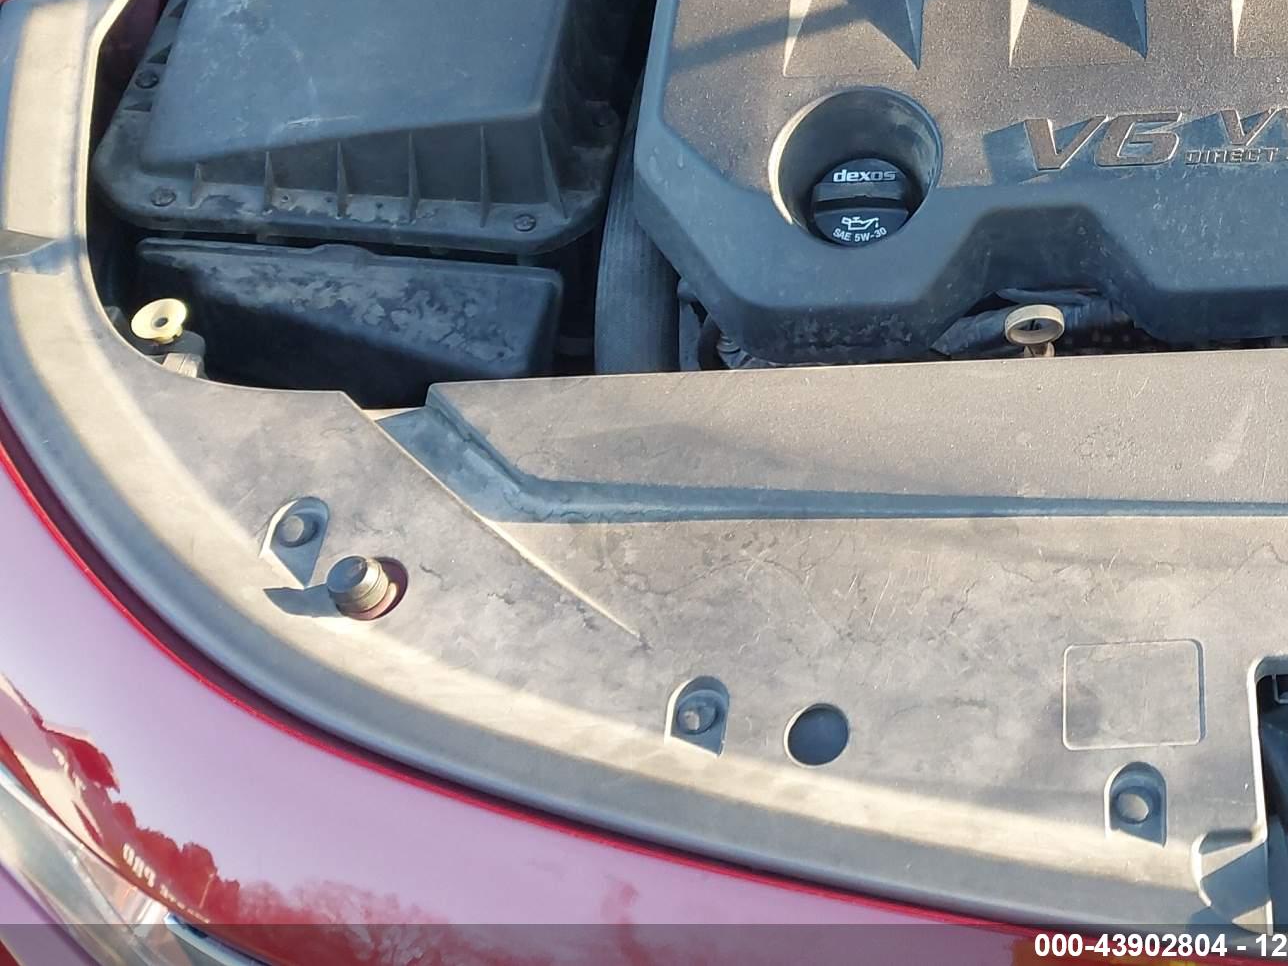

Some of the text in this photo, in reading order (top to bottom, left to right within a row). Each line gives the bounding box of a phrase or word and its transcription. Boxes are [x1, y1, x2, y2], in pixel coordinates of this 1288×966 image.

[1022, 112, 1184, 172] V6
[1184, 146, 1280, 166] DIRECT
[832, 169, 897, 183] dexos
[832, 226, 887, 243] SAE 5W-30
